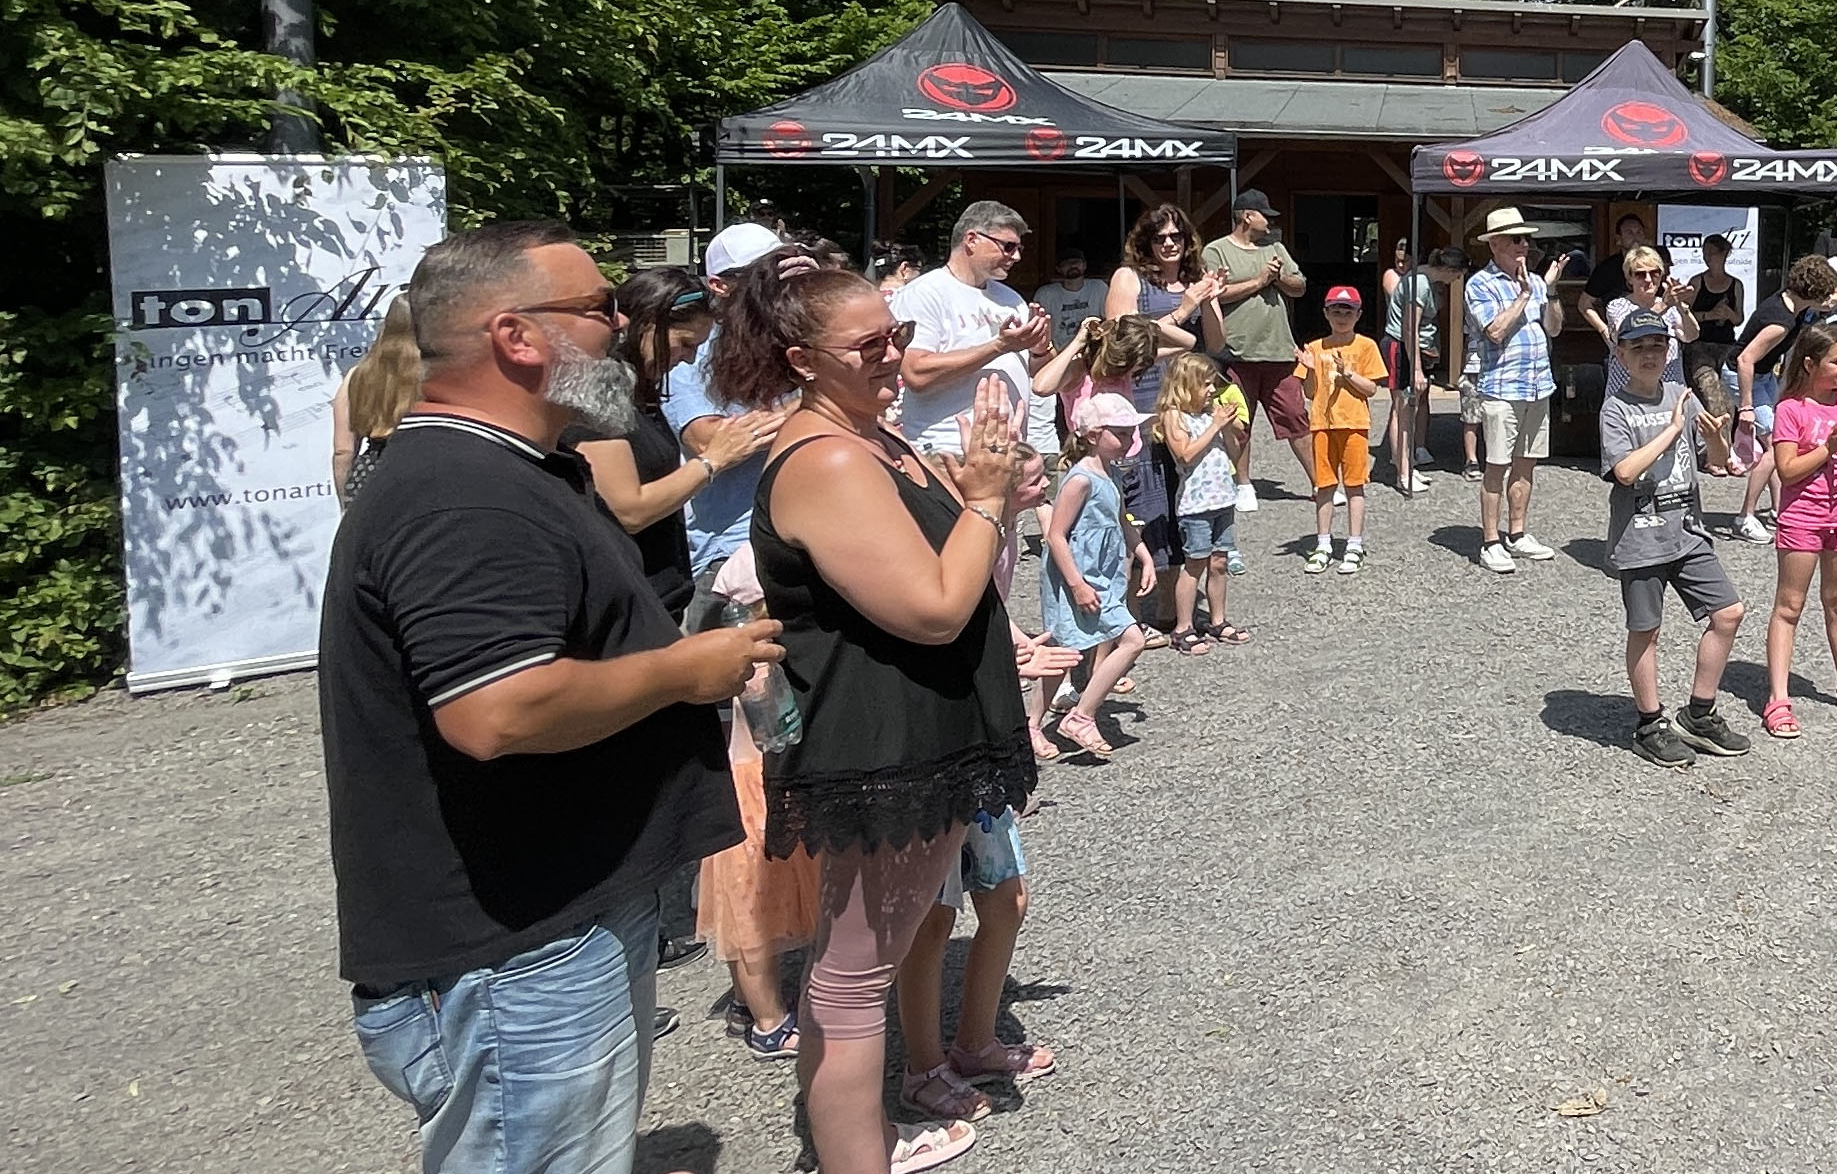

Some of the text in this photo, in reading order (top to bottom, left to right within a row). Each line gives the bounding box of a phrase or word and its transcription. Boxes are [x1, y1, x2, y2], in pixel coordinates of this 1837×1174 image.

[900, 107, 1057, 127] 24MX
[820, 132, 975, 158] 24MX
[1074, 136, 1204, 159] 24MX
[1489, 157, 1625, 182] 24MX
[138, 265, 411, 348] ton Ar
[236, 345, 315, 364] macht
[164, 479, 333, 511] www.tonarti
